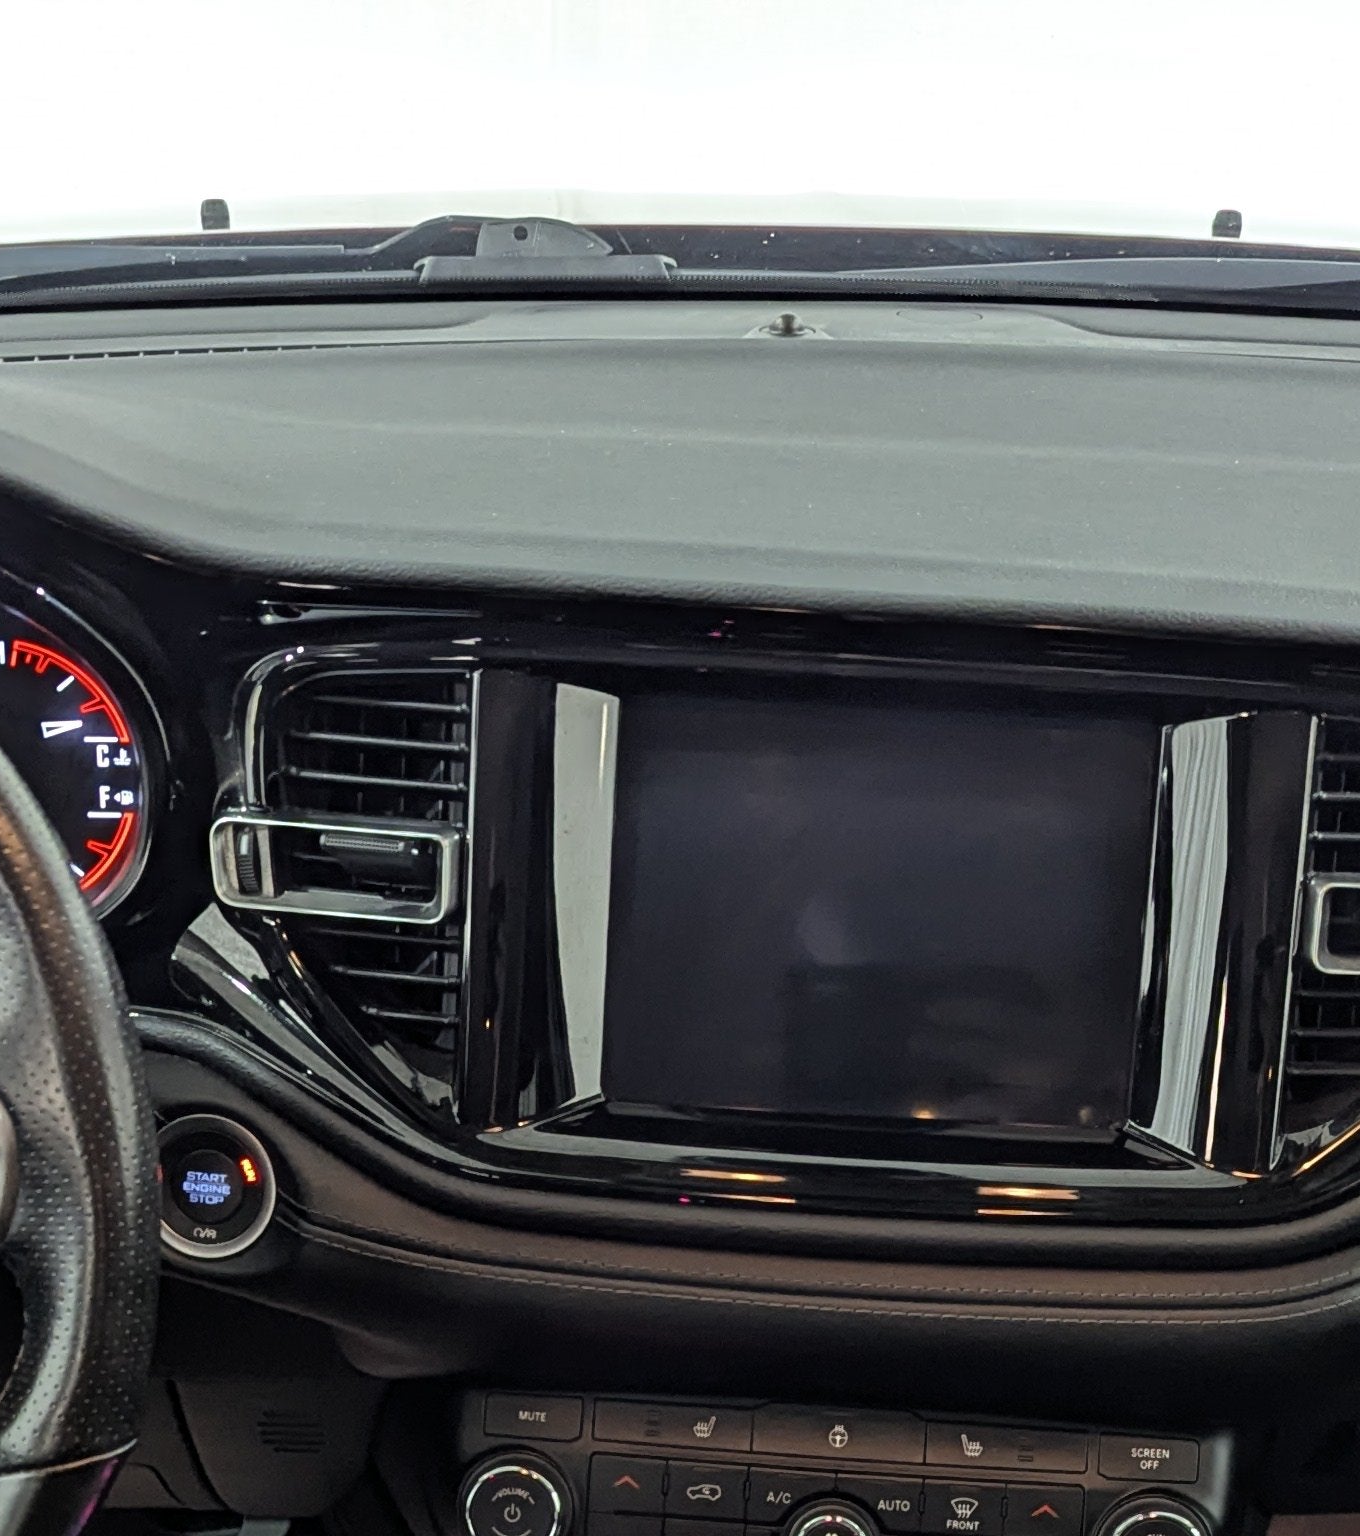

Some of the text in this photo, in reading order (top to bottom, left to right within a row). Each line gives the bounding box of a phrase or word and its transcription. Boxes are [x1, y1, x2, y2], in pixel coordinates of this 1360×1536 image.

[96, 745, 109, 768] C
[99, 785, 111, 808] F
[186, 1170, 228, 1183] START
[183, 1181, 231, 1196] ENGINE
[189, 1193, 224, 1205] STOP
[518, 1410, 547, 1423] MUTE
[1131, 1447, 1170, 1459] SCREEN
[1140, 1459, 1160, 1470] OFF
[497, 1487, 530, 1501] VOLUME
[766, 1490, 792, 1505] A/C
[877, 1500, 910, 1512] AUTO
[946, 1520, 980, 1531] FRONT
